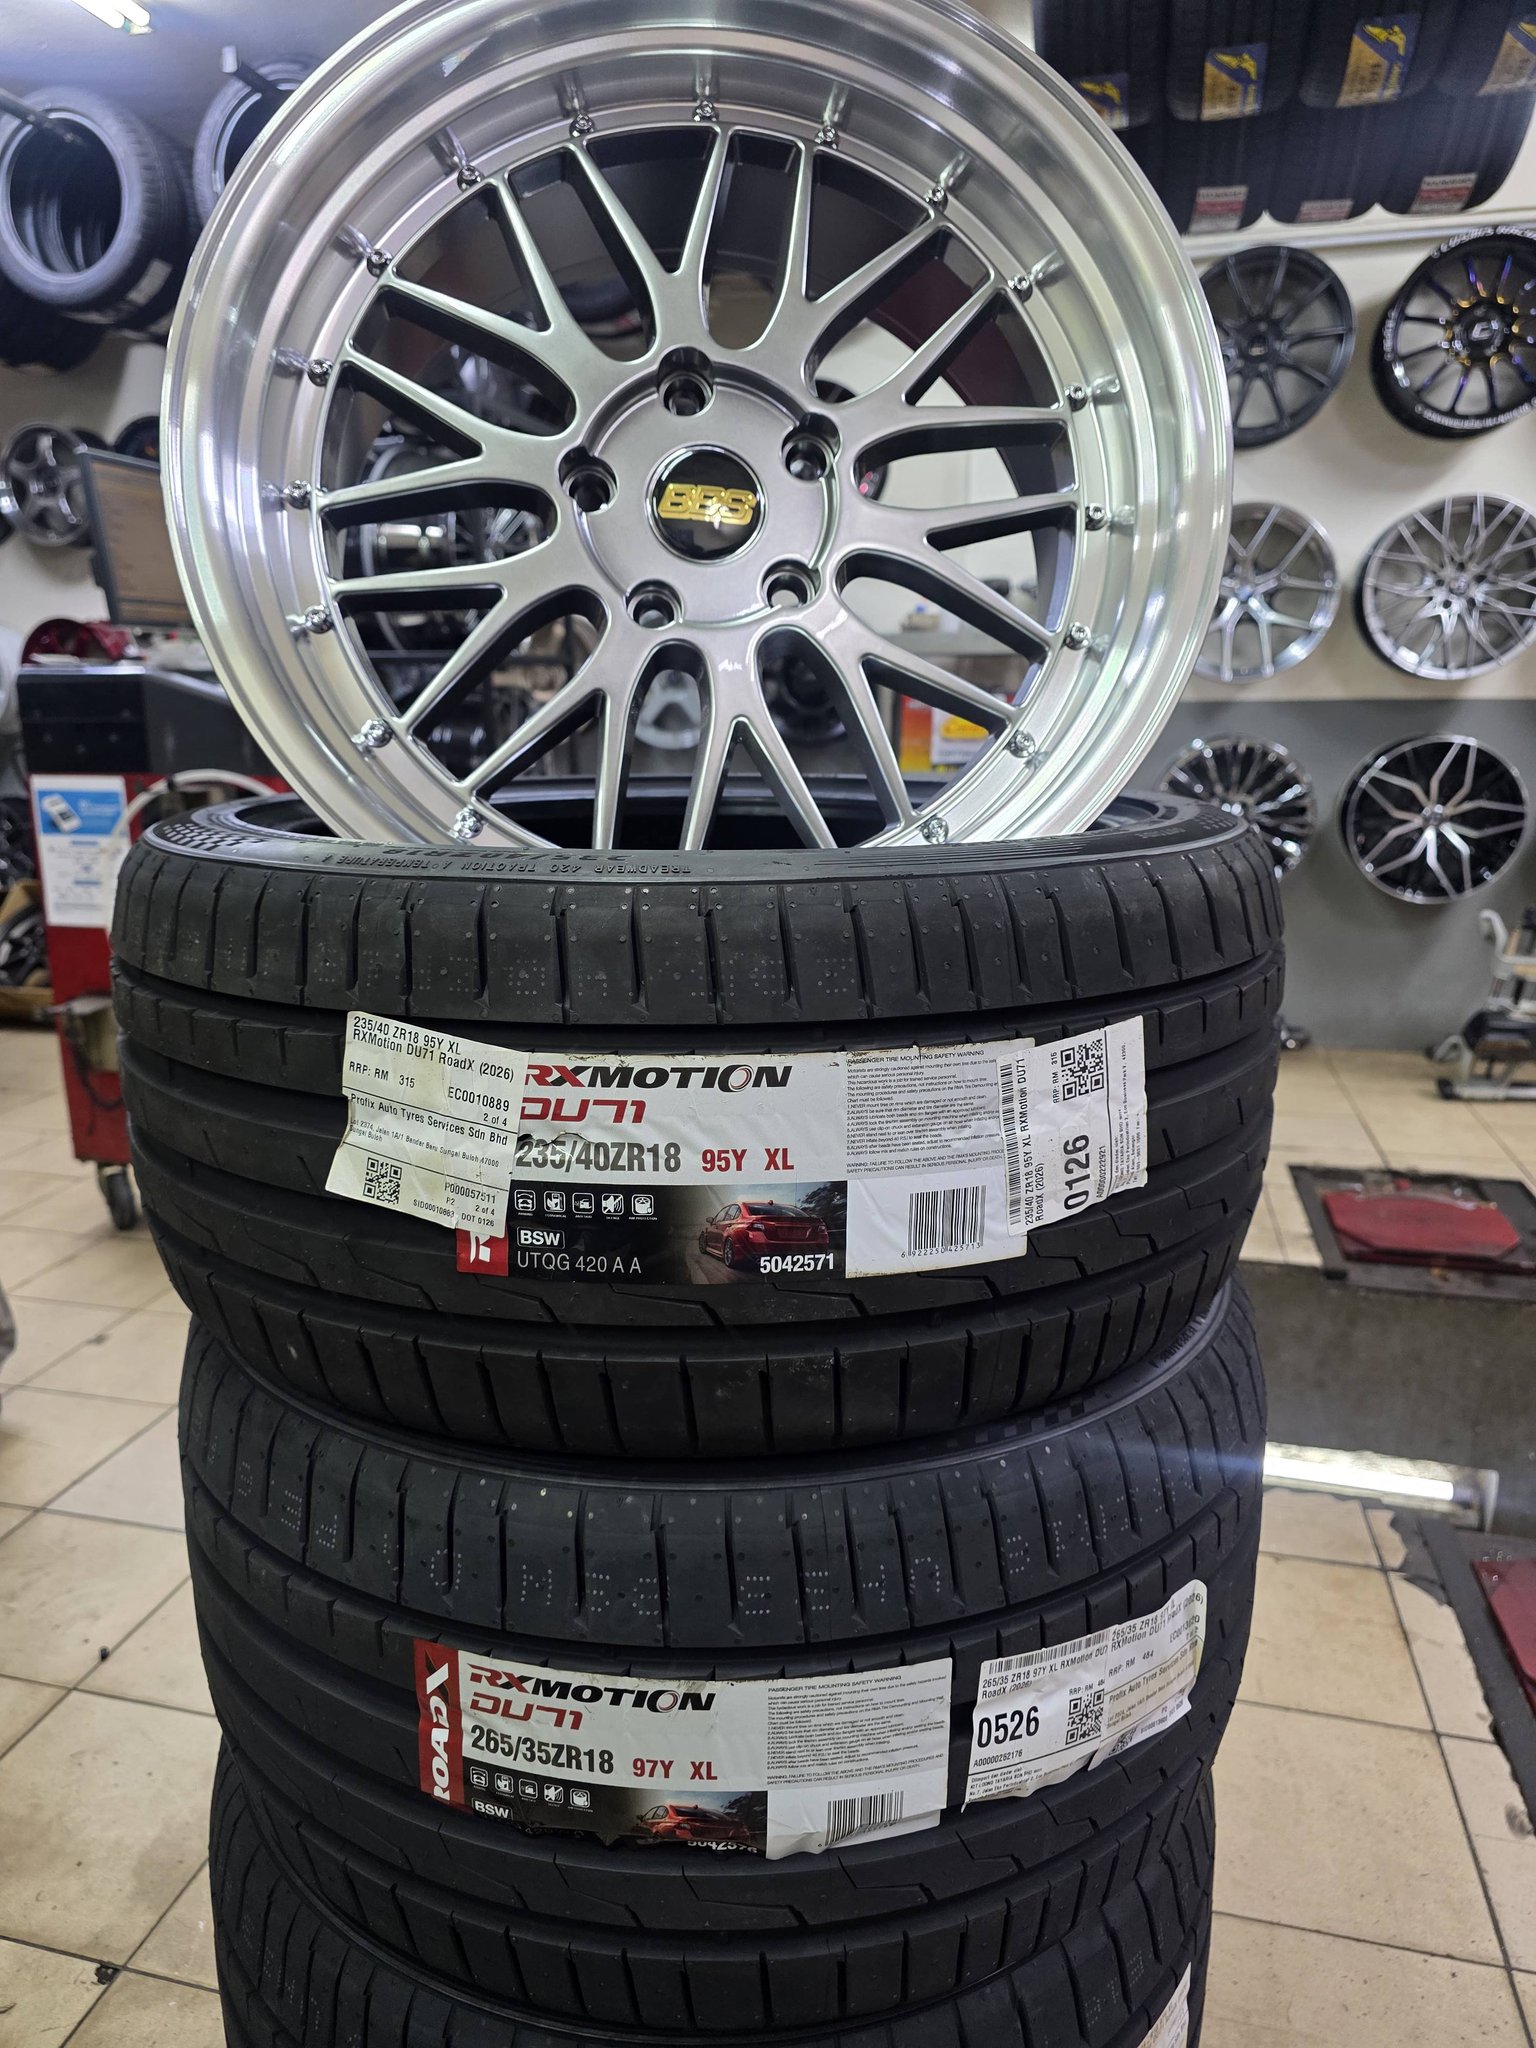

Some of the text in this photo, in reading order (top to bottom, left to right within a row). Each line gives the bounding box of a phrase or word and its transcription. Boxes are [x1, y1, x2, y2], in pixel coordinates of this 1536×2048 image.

[658, 482, 757, 526] BBS
[336, 855, 430, 869] TEMPERATURE
[460, 862, 536, 872] TRACTION
[550, 864, 582, 873] 420
[594, 864, 691, 874] TREADWEAR
[353, 1016, 461, 1055] 235/40 ZR18 95Y XL
[353, 1028, 514, 1083] RXMotion DU71 RoadX (2026)
[349, 1061, 416, 1088] RRP: RM 315
[524, 1063, 792, 1093] RXMOTION
[1052, 1071, 1059, 1084] RM
[447, 1086, 510, 1112] EC0010889
[1052, 1085, 1060, 1104] RRP:
[350, 1093, 508, 1146] Profix Auto Tyres Services Sdn Bhd
[483, 1113, 508, 1126] 2 of 4
[520, 1097, 646, 1124] DU71
[1016, 1057, 1034, 1226] 235/40 ZR18 95Y XL RXMotion DU71
[515, 1140, 795, 1173] 235/40ZR18 95Y XL
[1063, 1134, 1091, 1210] 0126
[444, 1182, 496, 1204] P000057511
[1034, 1163, 1046, 1222] RoadX (2026)
[462, 1212, 476, 1223] DOT
[478, 1217, 495, 1227] 0126
[482, 1206, 489, 1215] of
[520, 1229, 561, 1246] BSW
[517, 1250, 642, 1274] UTQG 420 A A
[759, 1252, 834, 1274] 5042571
[1110, 1630, 1147, 1653] RXMotion
[1111, 1622, 1137, 1642] 265/35
[982, 1674, 1009, 1689] 265/35
[1011, 1669, 1031, 1683] ZR18
[1033, 1666, 1046, 1677] 97Y
[1049, 1663, 1058, 1673] XL
[1060, 1652, 1093, 1670] RXMotion
[1108, 1650, 1154, 1678] RRP: RM 484
[468, 1663, 716, 1713] RXMOTION
[874, 1675, 902, 1684] WARNING
[1069, 1686, 1083, 1696] RRP:
[1085, 1683, 1093, 1691] RM
[1108, 1688, 1127, 1704] Profix
[1127, 1680, 1141, 1694] Auto
[1142, 1671, 1157, 1686] Tyres
[981, 1685, 1007, 1700] RoadX
[469, 1691, 584, 1730] DU71
[977, 1705, 1040, 1748] 0526
[471, 1724, 718, 1781] 265/35ZR18 97Y XL
[474, 1800, 510, 1819] BSW
